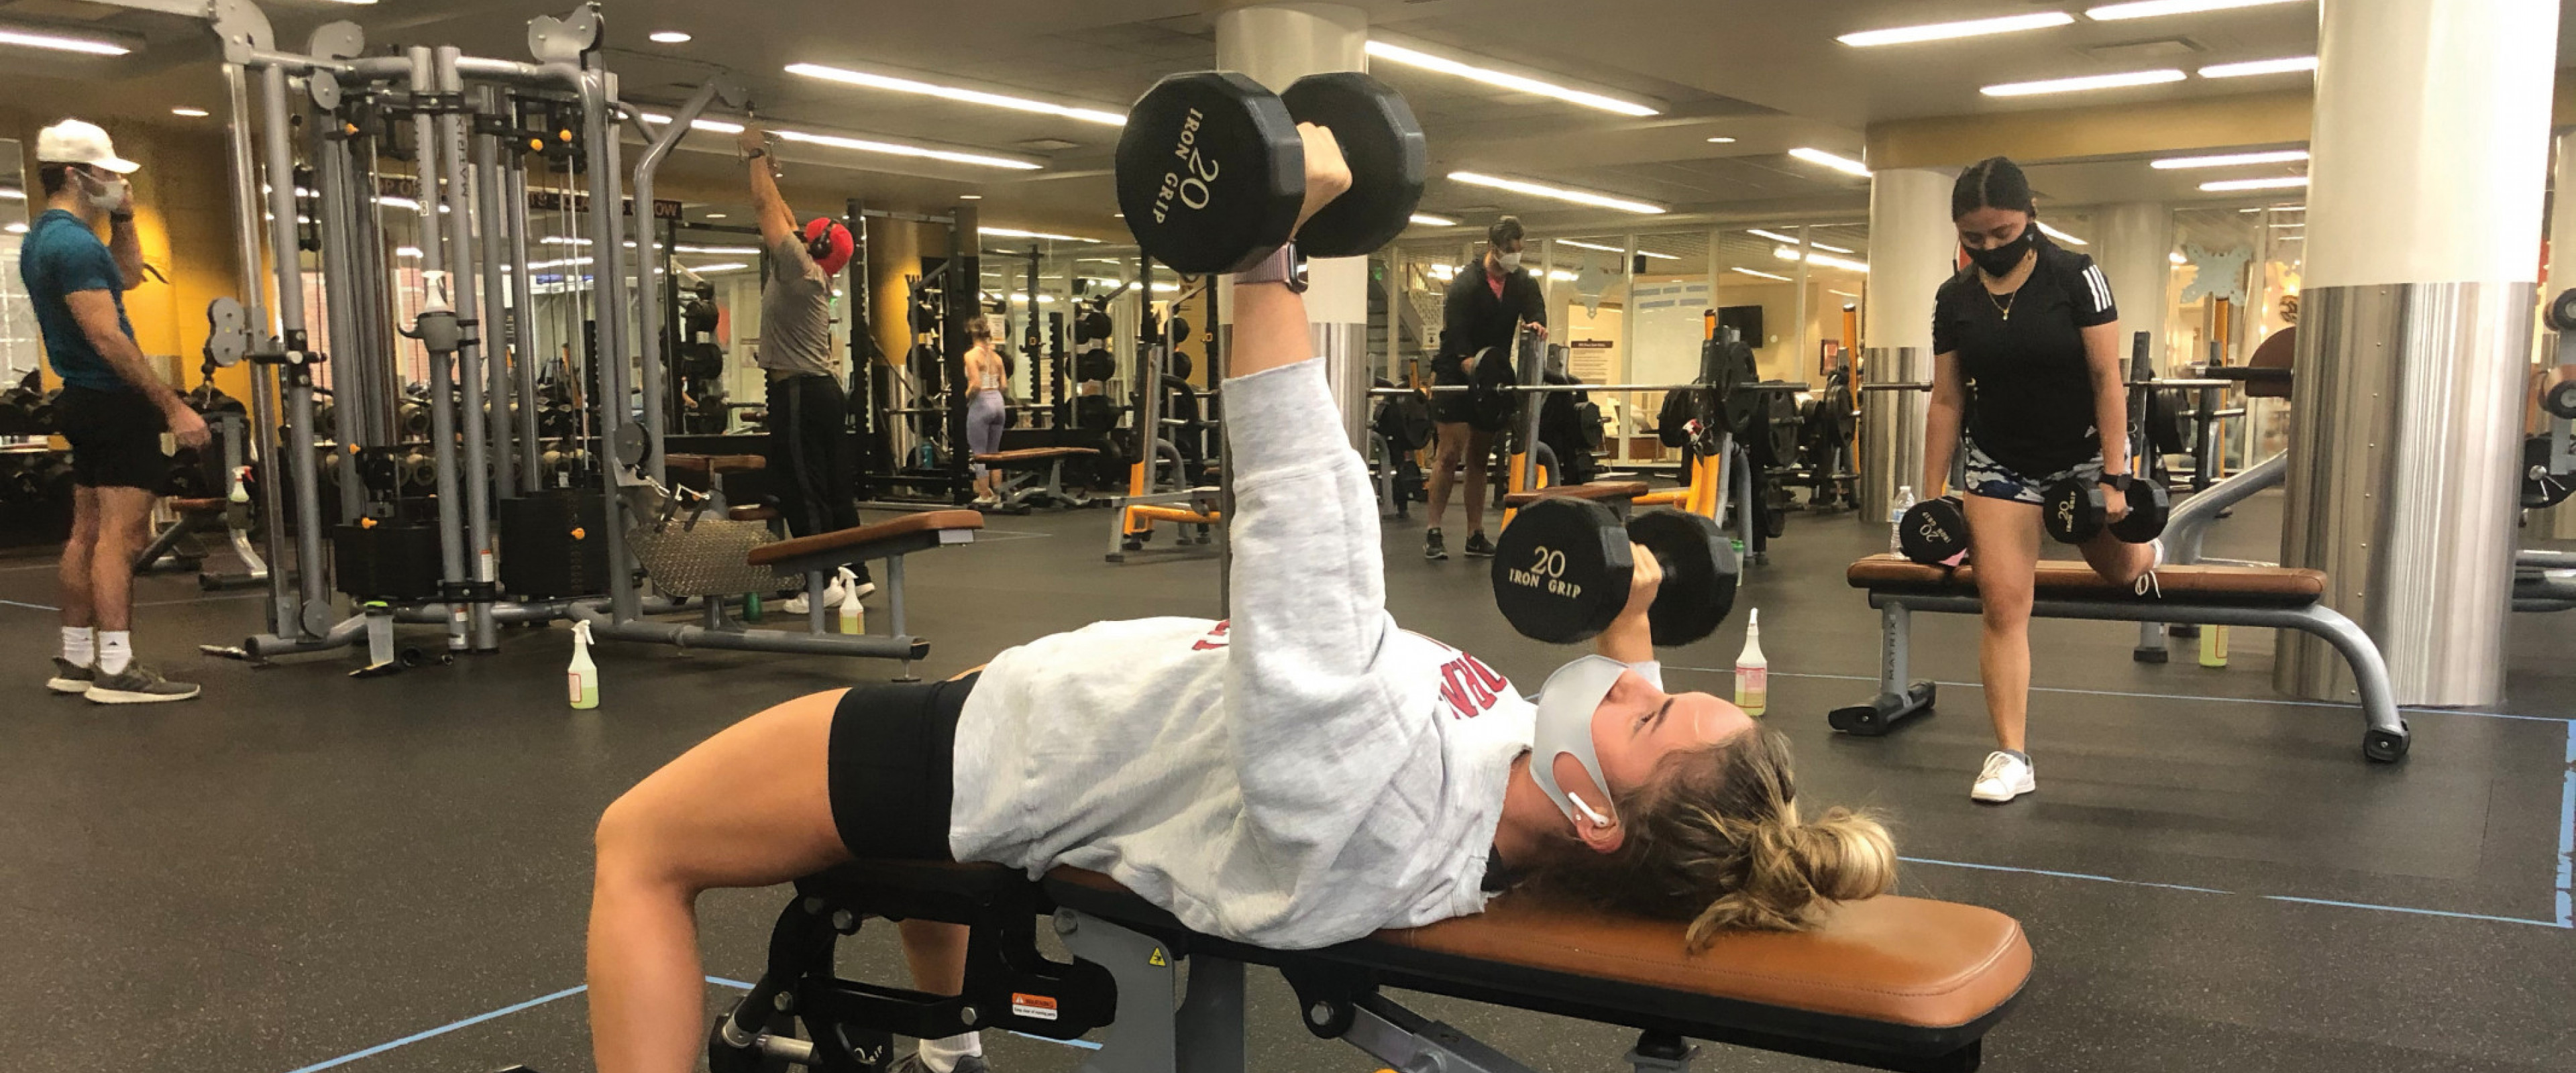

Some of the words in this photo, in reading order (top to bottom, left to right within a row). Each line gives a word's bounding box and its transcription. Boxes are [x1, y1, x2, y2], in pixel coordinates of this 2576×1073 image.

[1175, 107, 1203, 160] IRON
[457, 117, 469, 197] MATRIX
[1153, 172, 1178, 224] GRIP
[1180, 147, 1219, 210] 20
[2057, 501, 2069, 520] 20
[1920, 524, 1939, 542] 20
[1509, 567, 1540, 588] IRON
[1548, 579, 1582, 598] GRIP
[1530, 545, 1566, 578] 20
